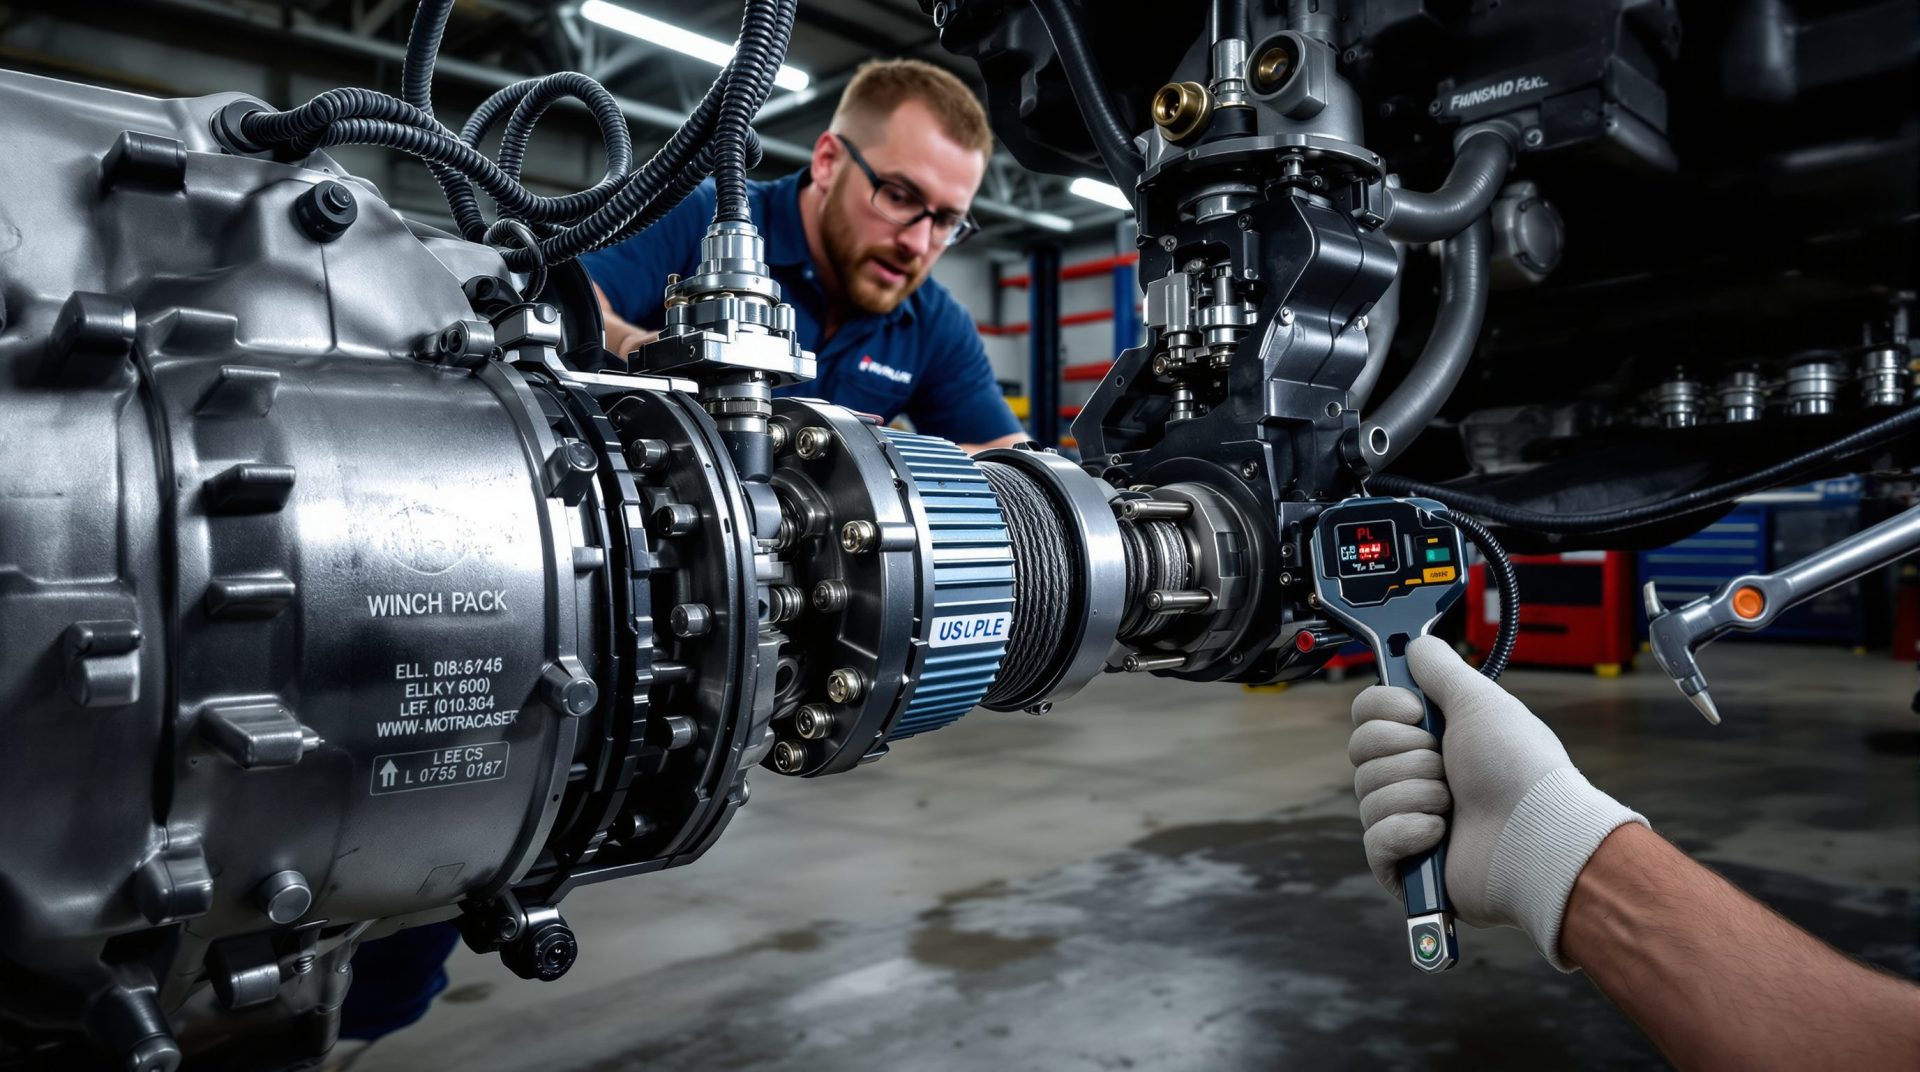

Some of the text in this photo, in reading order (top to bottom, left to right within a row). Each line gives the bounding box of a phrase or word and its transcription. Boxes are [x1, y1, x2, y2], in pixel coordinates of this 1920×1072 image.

[1356, 527, 1374, 540] PL
[367, 590, 508, 617] WINCH PACK
[396, 663, 429, 679] ELL.
[459, 677, 490, 694] 600)
[400, 700, 431, 717] LEF.
[465, 747, 484, 761] CS
[404, 760, 503, 784] L 0755 0187
